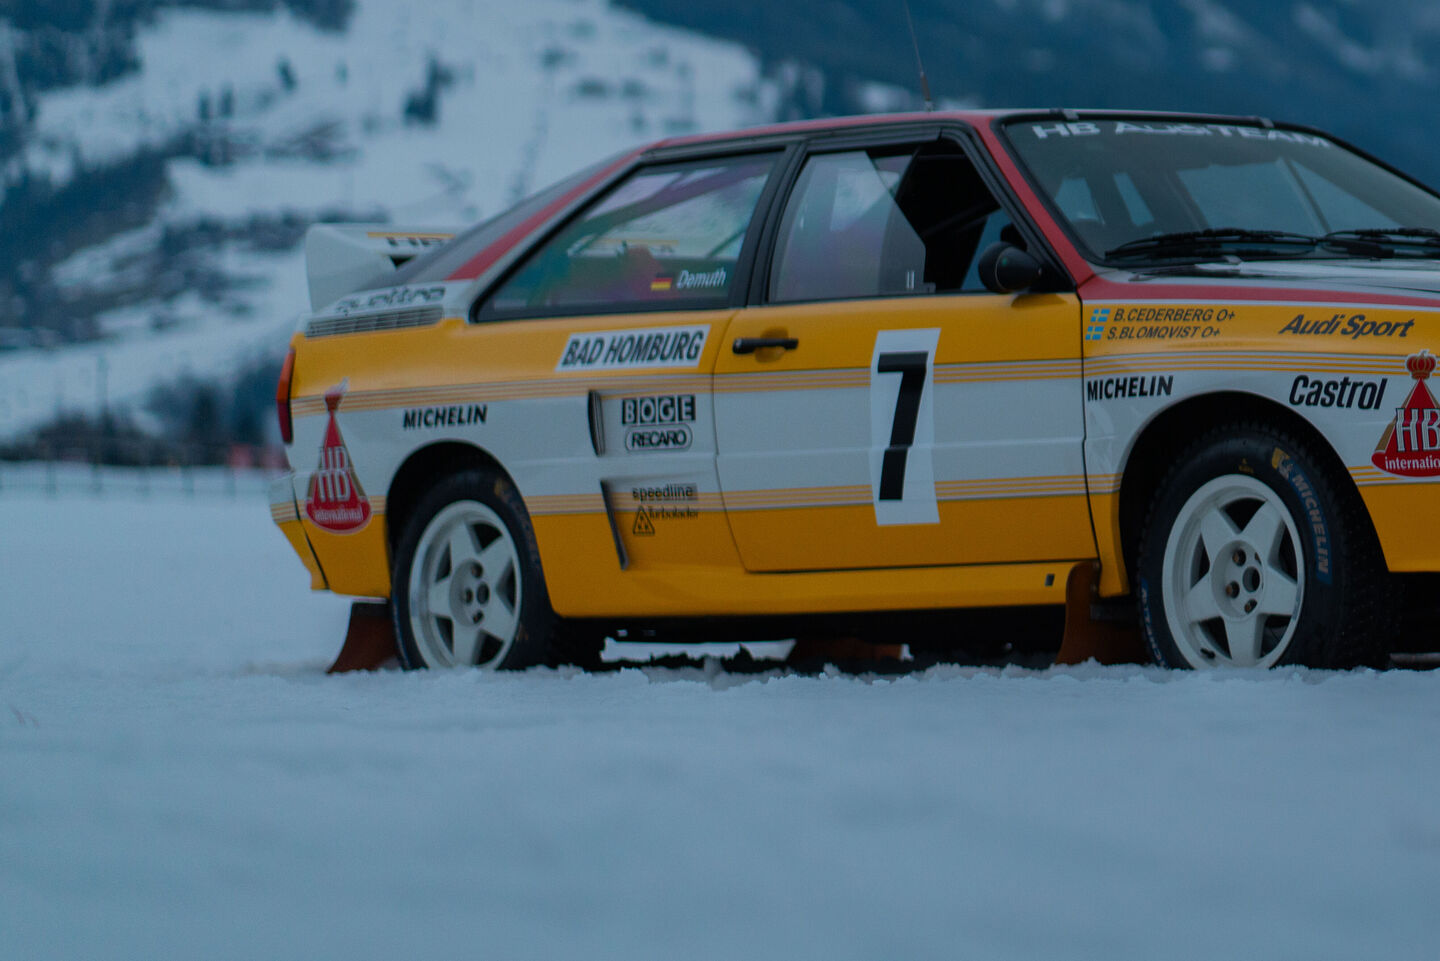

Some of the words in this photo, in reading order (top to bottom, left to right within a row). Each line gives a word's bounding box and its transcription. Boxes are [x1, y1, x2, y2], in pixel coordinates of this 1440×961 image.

[1033, 122, 1099, 139] HB
[1113, 308, 1213, 322] B.CEDERBERG
[1278, 314, 1345, 335] Audi
[1340, 315, 1416, 340] Sport
[1107, 326, 1201, 340] S.BLOMQVIST
[561, 337, 605, 366] BAD
[603, 330, 705, 364] HOMBURG
[1087, 375, 1174, 402] MICHELIN
[1288, 374, 1388, 410] Castrol
[403, 404, 488, 429] MICHELIN
[622, 395, 696, 425] BOGE
[631, 429, 688, 448] RECARO
[877, 351, 929, 501] 7
[632, 483, 694, 501] speedline
[1291, 474, 1329, 575] MICHELIN
